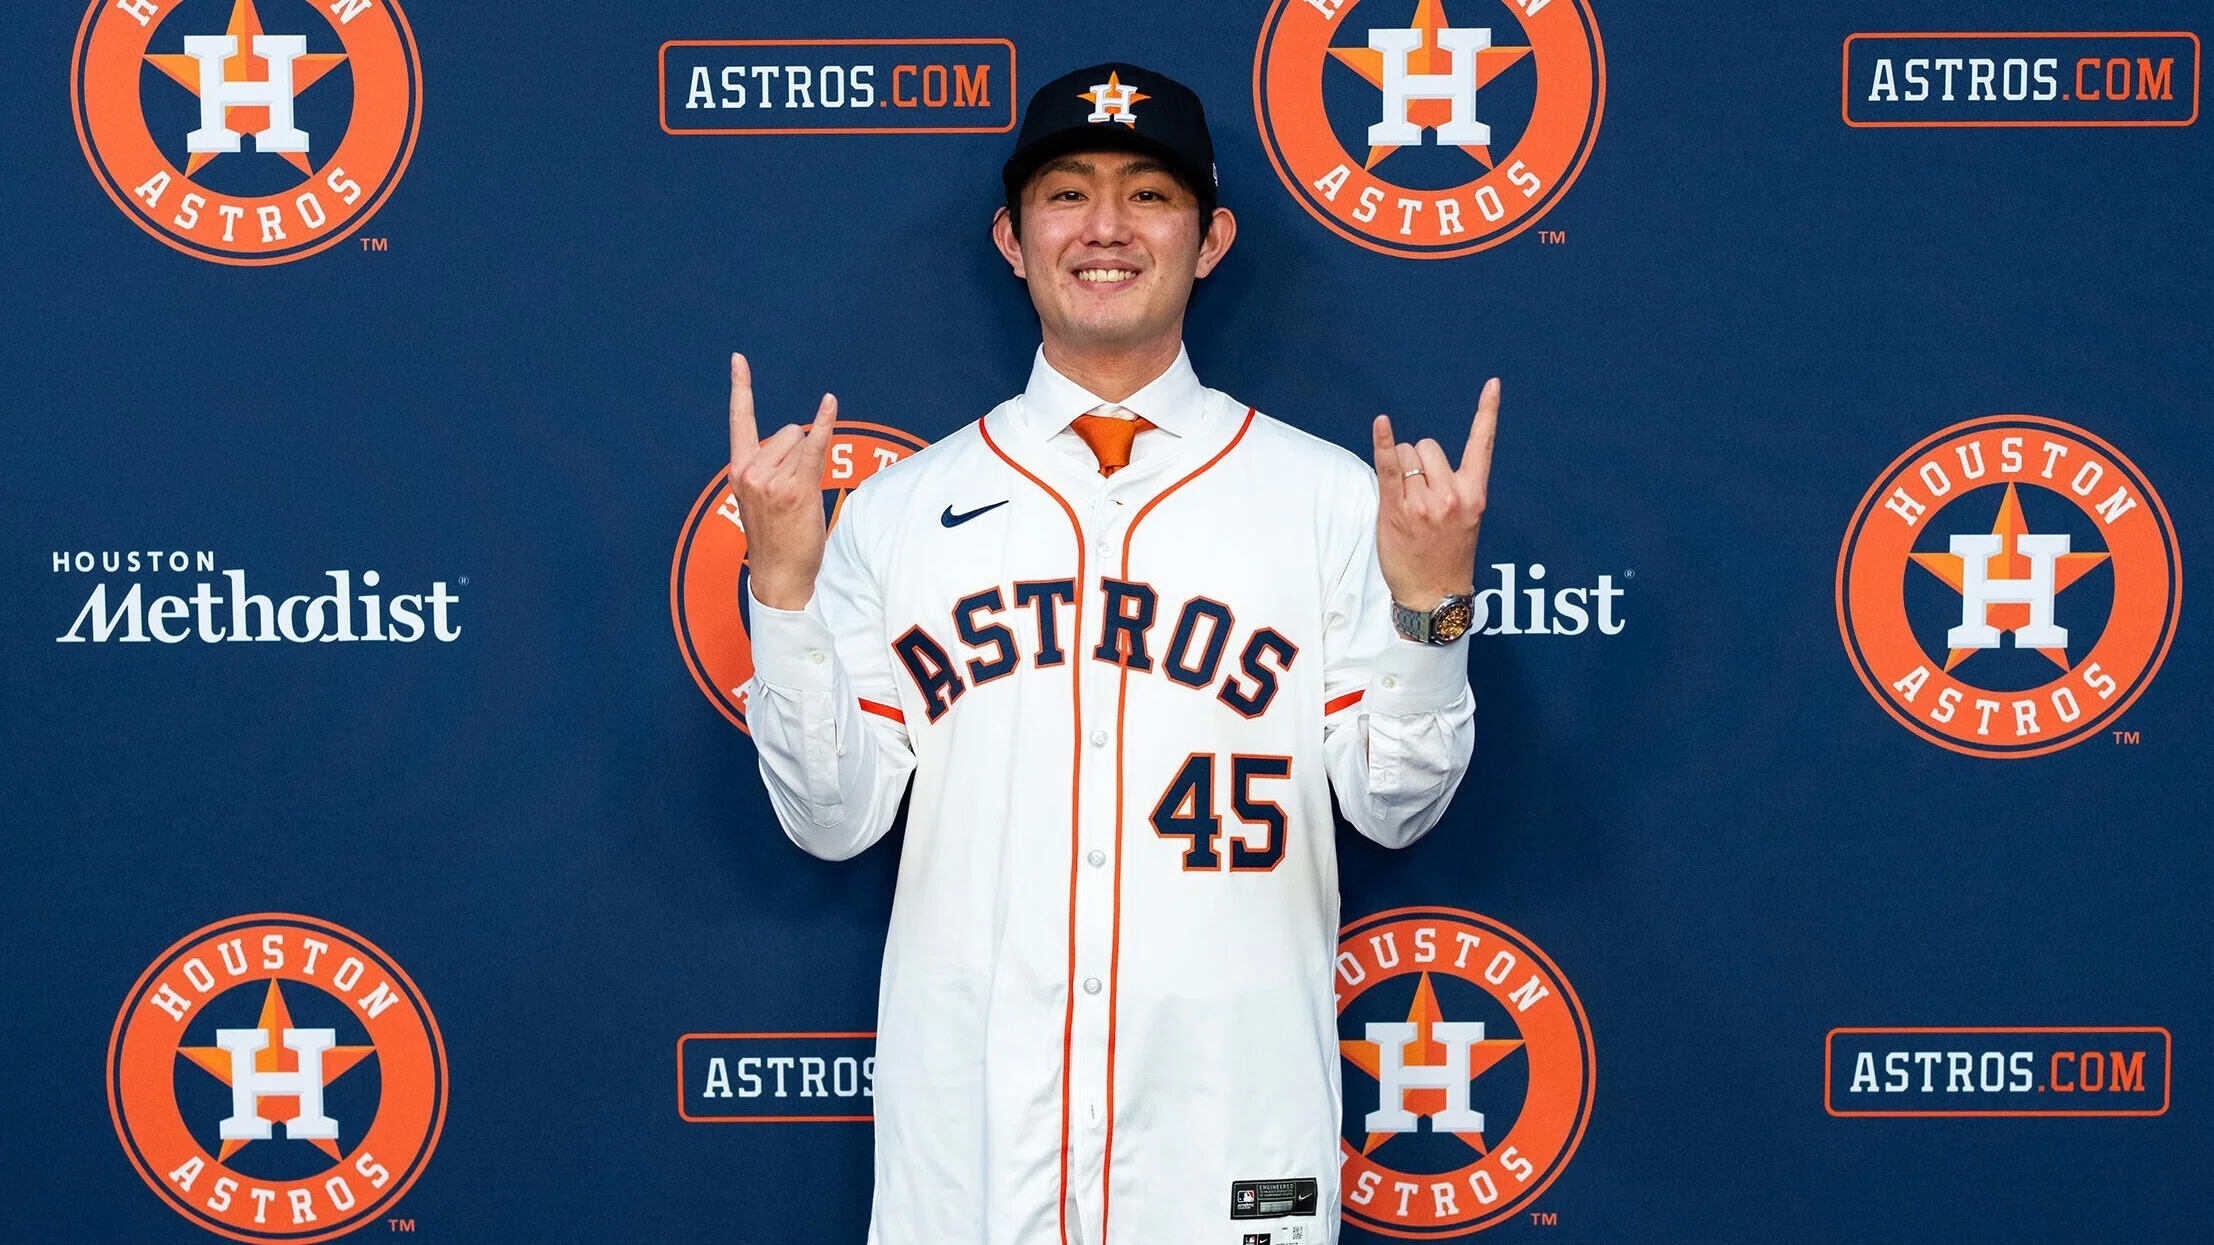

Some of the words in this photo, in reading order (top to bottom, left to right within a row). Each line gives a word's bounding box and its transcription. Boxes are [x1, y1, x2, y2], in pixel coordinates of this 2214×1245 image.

[183, 34, 310, 153] H
[685, 64, 990, 109] ASTROS.COM
[1087, 83, 1139, 123] H
[1367, 27, 1492, 147] H
[1868, 57, 2174, 101] ASTROS.COM
[134, 166, 361, 243] ASTROS
[1313, 159, 1541, 236] ASTROS
[360, 238, 388, 251] TM
[1538, 231, 1566, 244] TM
[1885, 437, 2137, 527] HOUSTON
[52, 550, 215, 572] HOUSTON
[1947, 533, 2071, 649] H
[892, 576, 1300, 725] ASTROS
[1893, 662, 2116, 736] ASTROS
[2112, 731, 2140, 745] TM
[1148, 752, 1293, 872] 45
[150, 934, 400, 1022] HOUSTON
[1336, 927, 1550, 1013] OUSTON
[216, 1027, 339, 1140] H
[1365, 1021, 1485, 1133] H
[1850, 1051, 2146, 1092] ASTROS.COM
[168, 1152, 390, 1224] ASTROS
[1340, 1146, 1534, 1218] STROS
[1530, 1212, 1558, 1226] TM
[388, 1218, 415, 1232] TM
